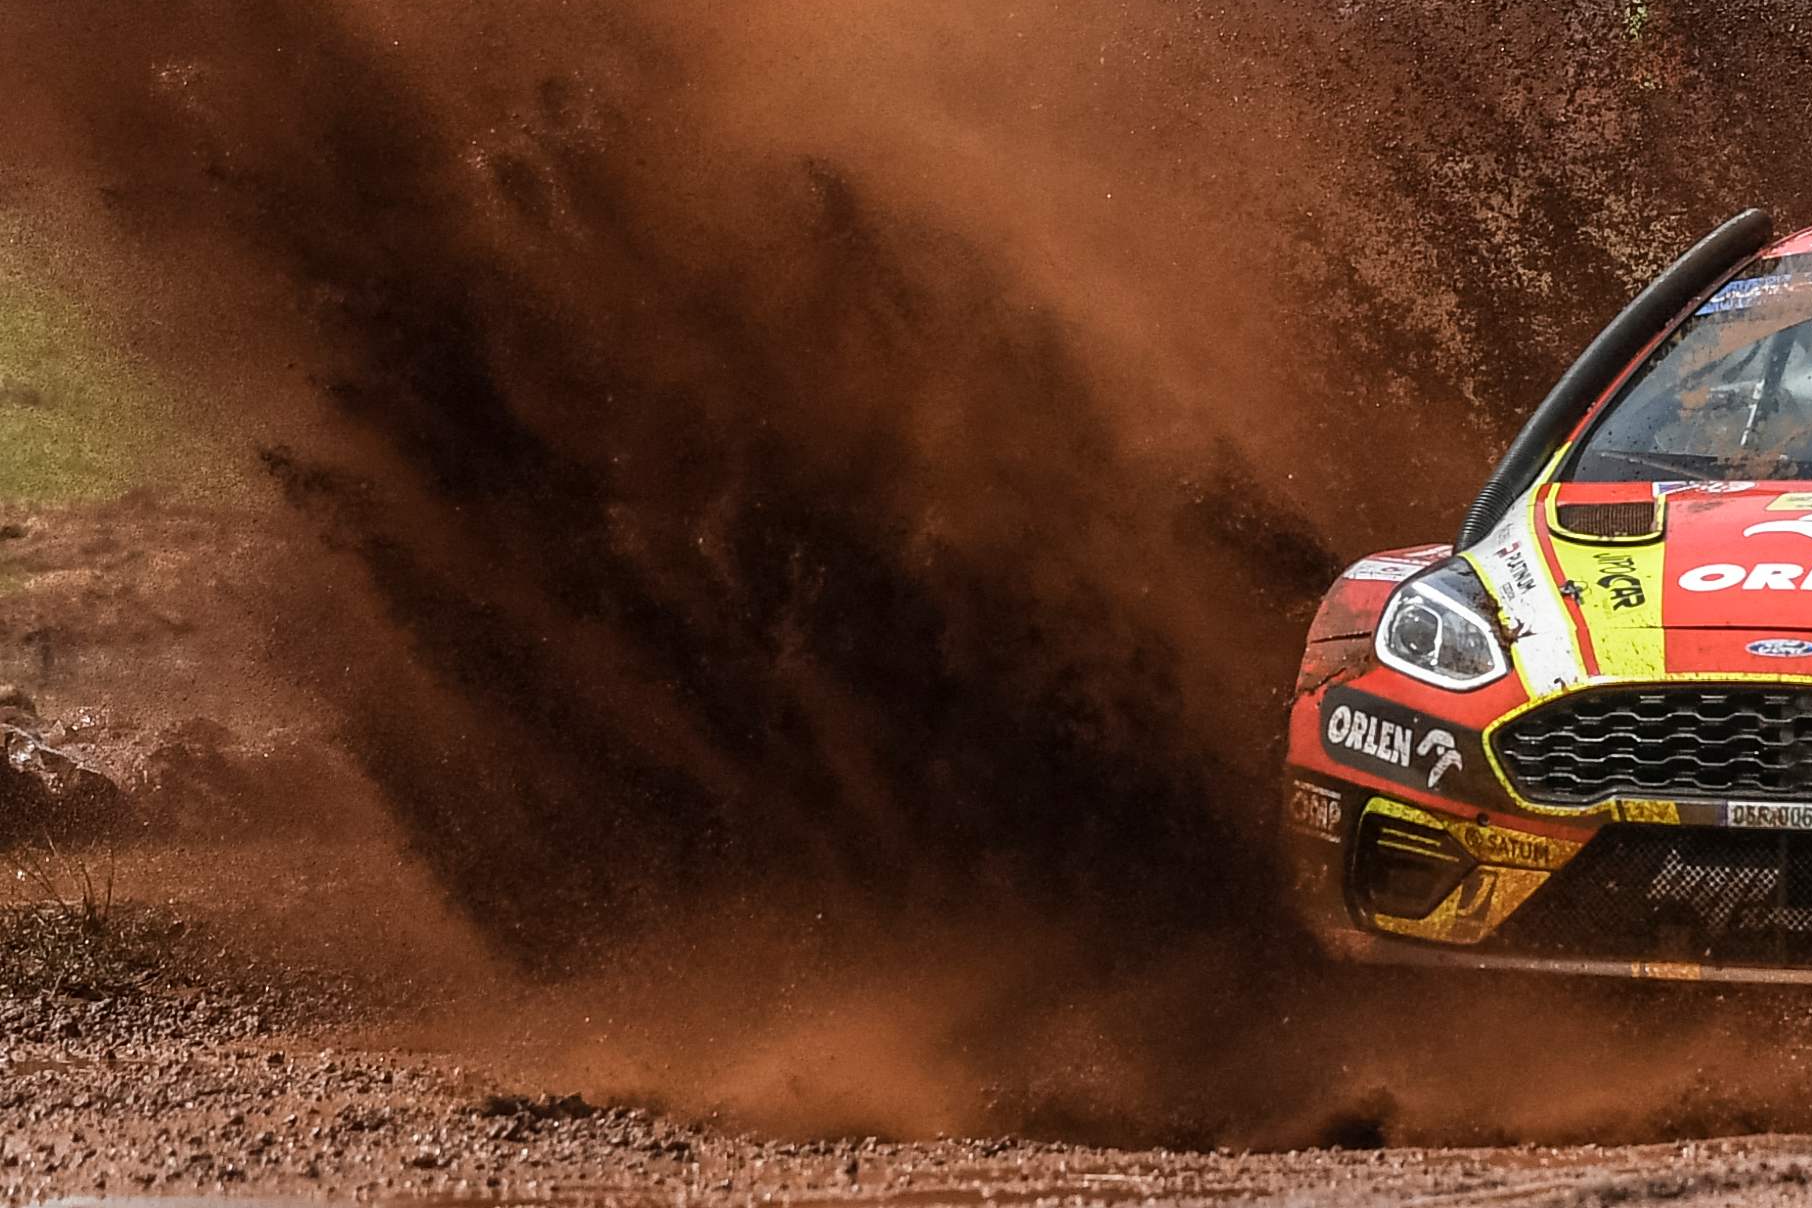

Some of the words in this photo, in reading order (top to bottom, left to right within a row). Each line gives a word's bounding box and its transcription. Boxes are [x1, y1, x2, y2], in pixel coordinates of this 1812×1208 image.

[1593, 552, 1646, 611] JIPOCAR
[1327, 705, 1413, 767] ORLEN
[1487, 832, 1549, 862] SATUM
